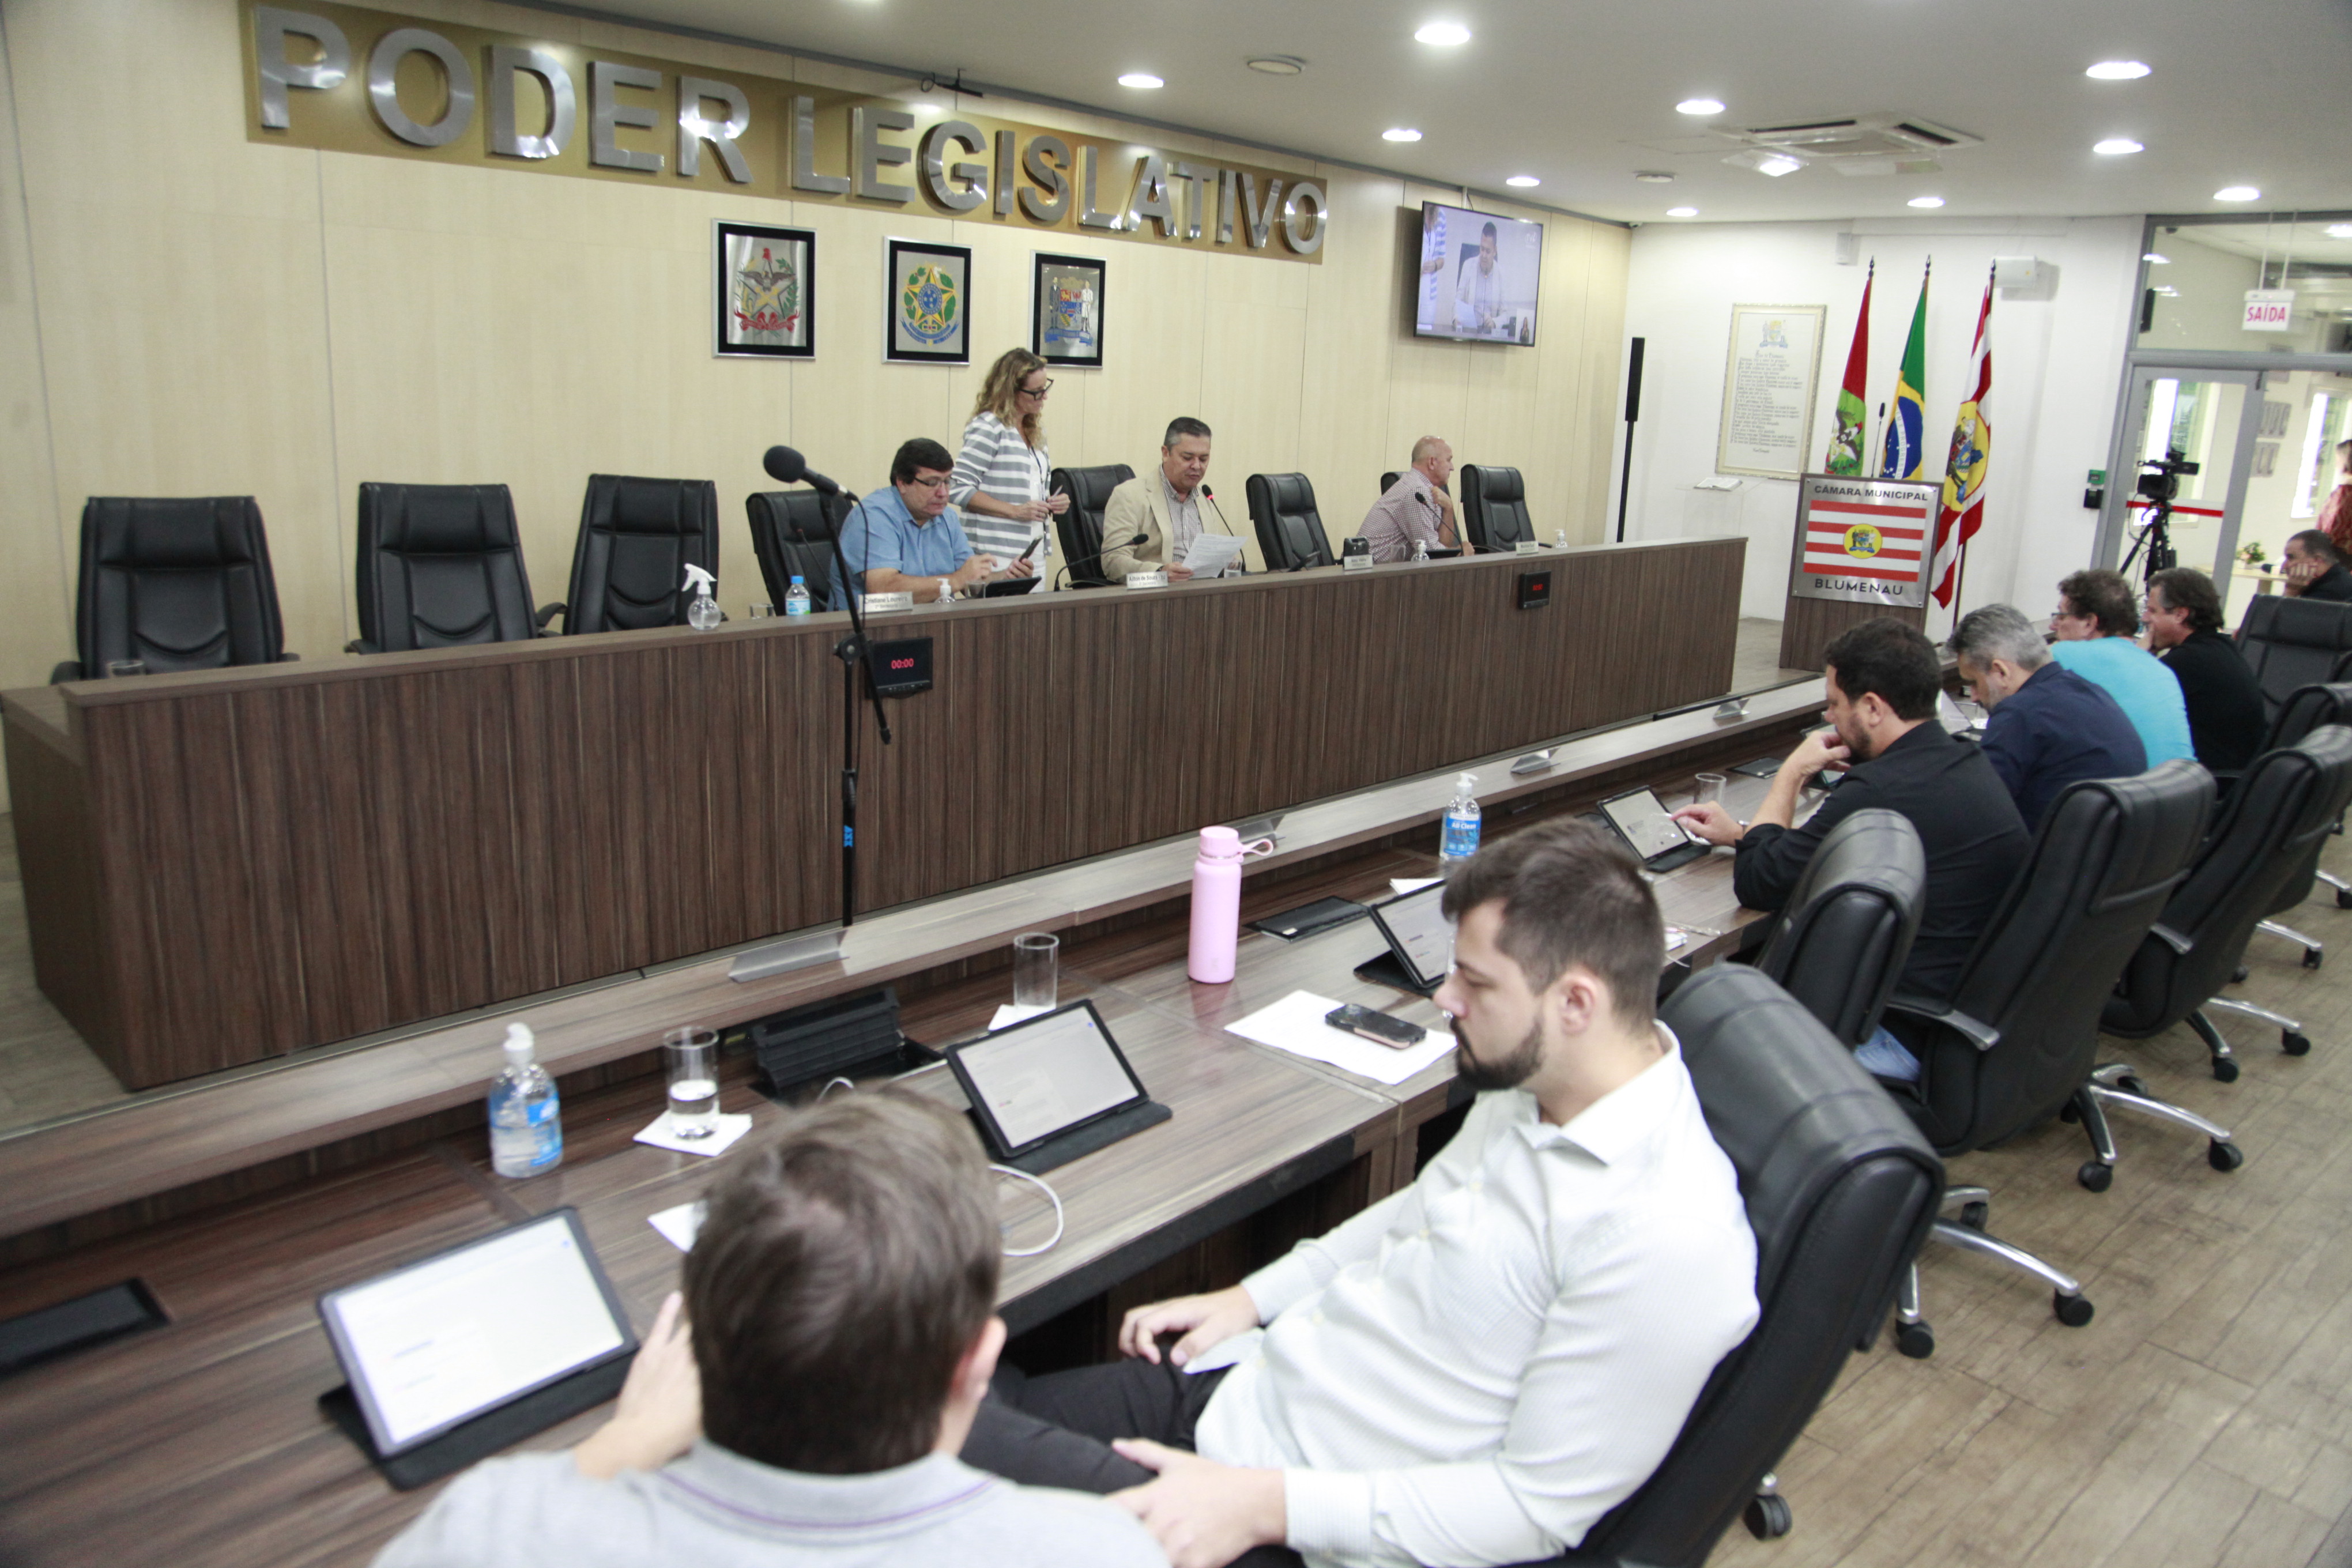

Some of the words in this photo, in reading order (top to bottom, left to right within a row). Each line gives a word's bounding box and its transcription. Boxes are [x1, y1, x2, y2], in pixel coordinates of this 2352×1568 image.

[254, 5, 753, 183] PODER
[789, 95, 1328, 255] LEGISLATIVO
[2246, 304, 2286, 322] SAÍDA
[1814, 484, 1861, 496] CÂMARA
[1865, 489, 1928, 501] MUNICIPAL
[1815, 579, 1904, 595] BLUMENAU
[891, 658, 914, 669] 00:00
